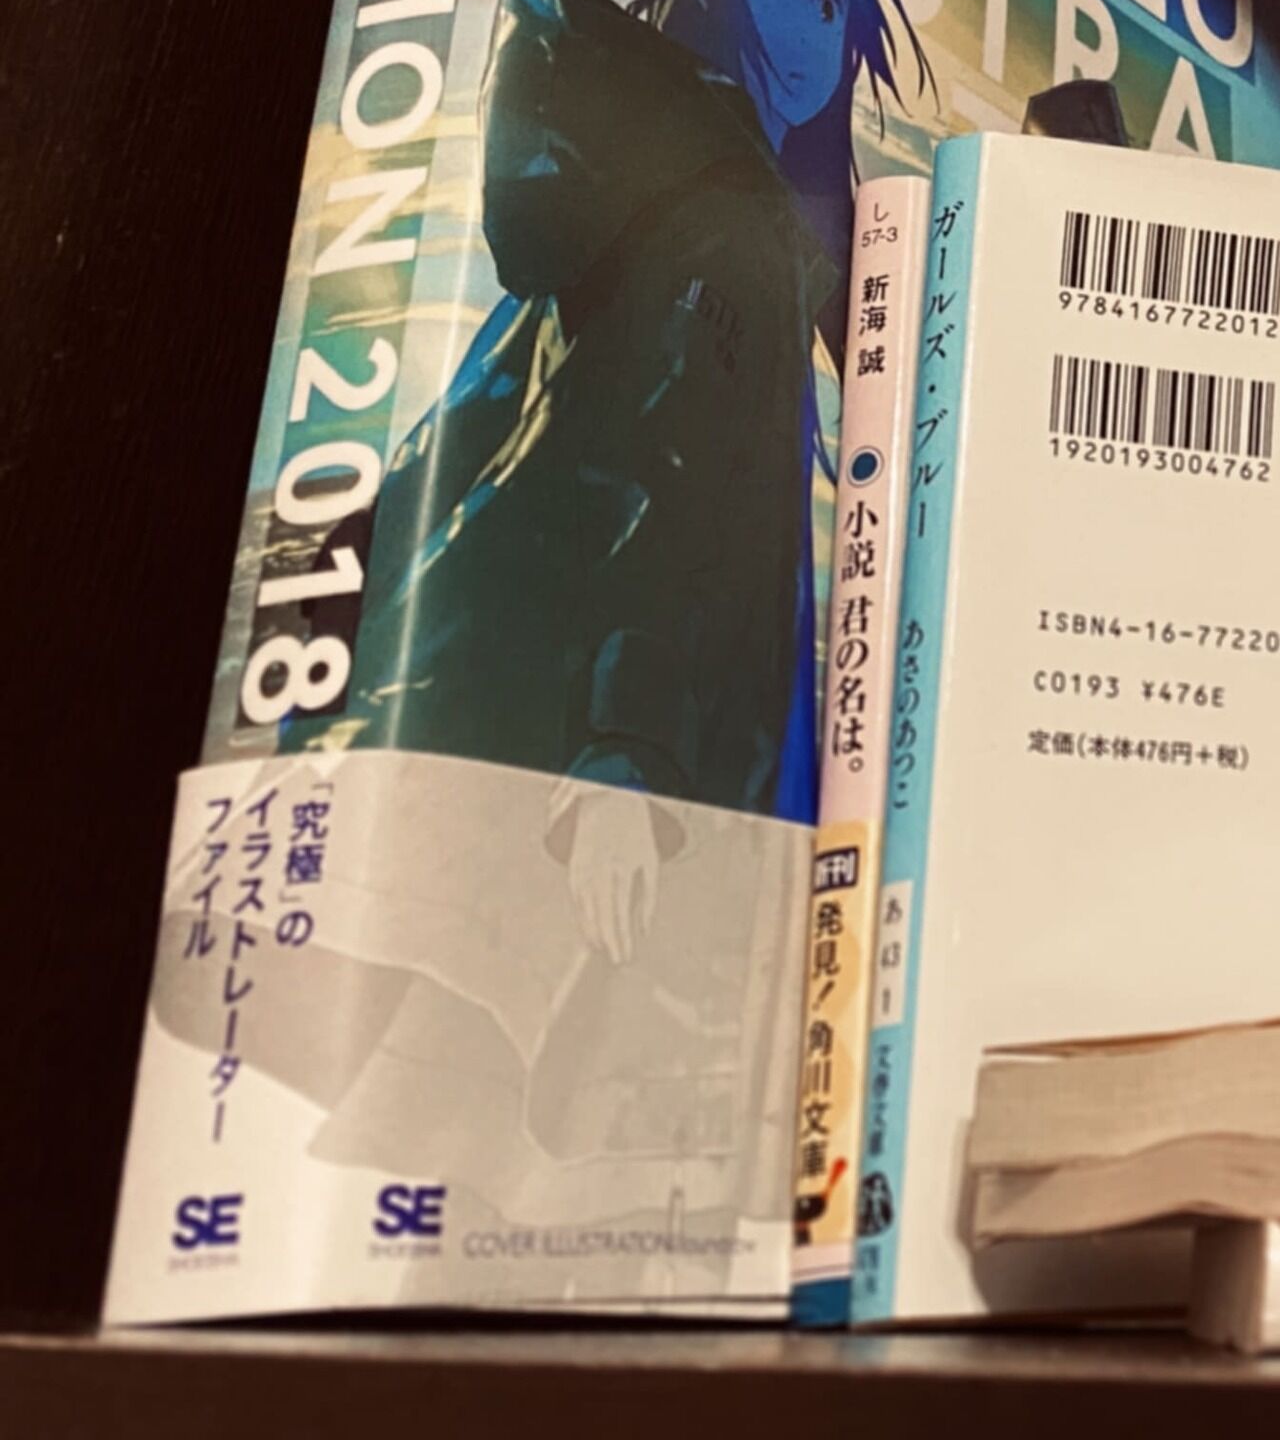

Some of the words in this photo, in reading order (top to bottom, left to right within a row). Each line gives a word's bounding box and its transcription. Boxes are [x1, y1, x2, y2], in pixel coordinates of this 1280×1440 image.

[861, 228, 899, 248] 57-3
[1058, 290, 1279, 339] 9784167722012
[914, 200, 965, 539] ガールズ・ブルー
[240, 336, 399, 725] 2018
[1049, 437, 1271, 483] 1920193004762
[832, 597, 874, 774] 君の名は。
[892, 618, 926, 810] あさのあつこ
[1033, 669, 1121, 700] C0193
[1140, 678, 1226, 709] ¥476E
[184, 797, 233, 960] ファイル
[276, 779, 335, 948] 「究極」の
[212, 786, 279, 1144] イラストレーター
[171, 1192, 245, 1251] SE
[371, 1182, 448, 1238] SE
